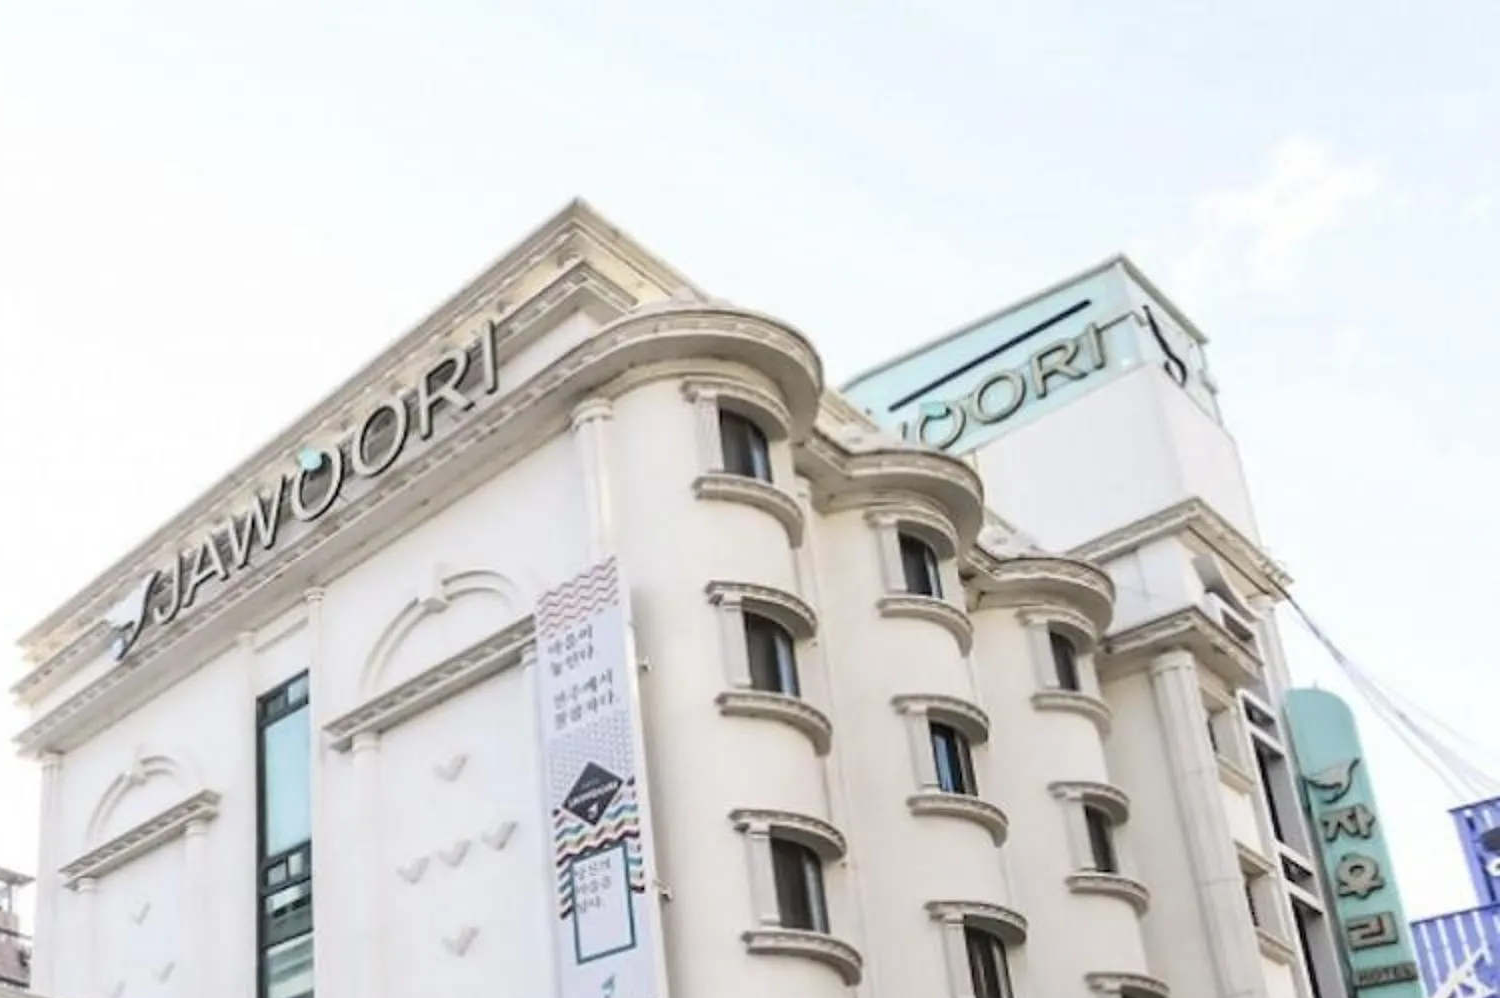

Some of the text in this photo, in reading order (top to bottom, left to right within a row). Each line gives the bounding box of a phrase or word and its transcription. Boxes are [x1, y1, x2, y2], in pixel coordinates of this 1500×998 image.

[900, 321, 1106, 452] OORI
[152, 317, 502, 624] JAWOORI
[1321, 803, 1399, 951] 자우리
